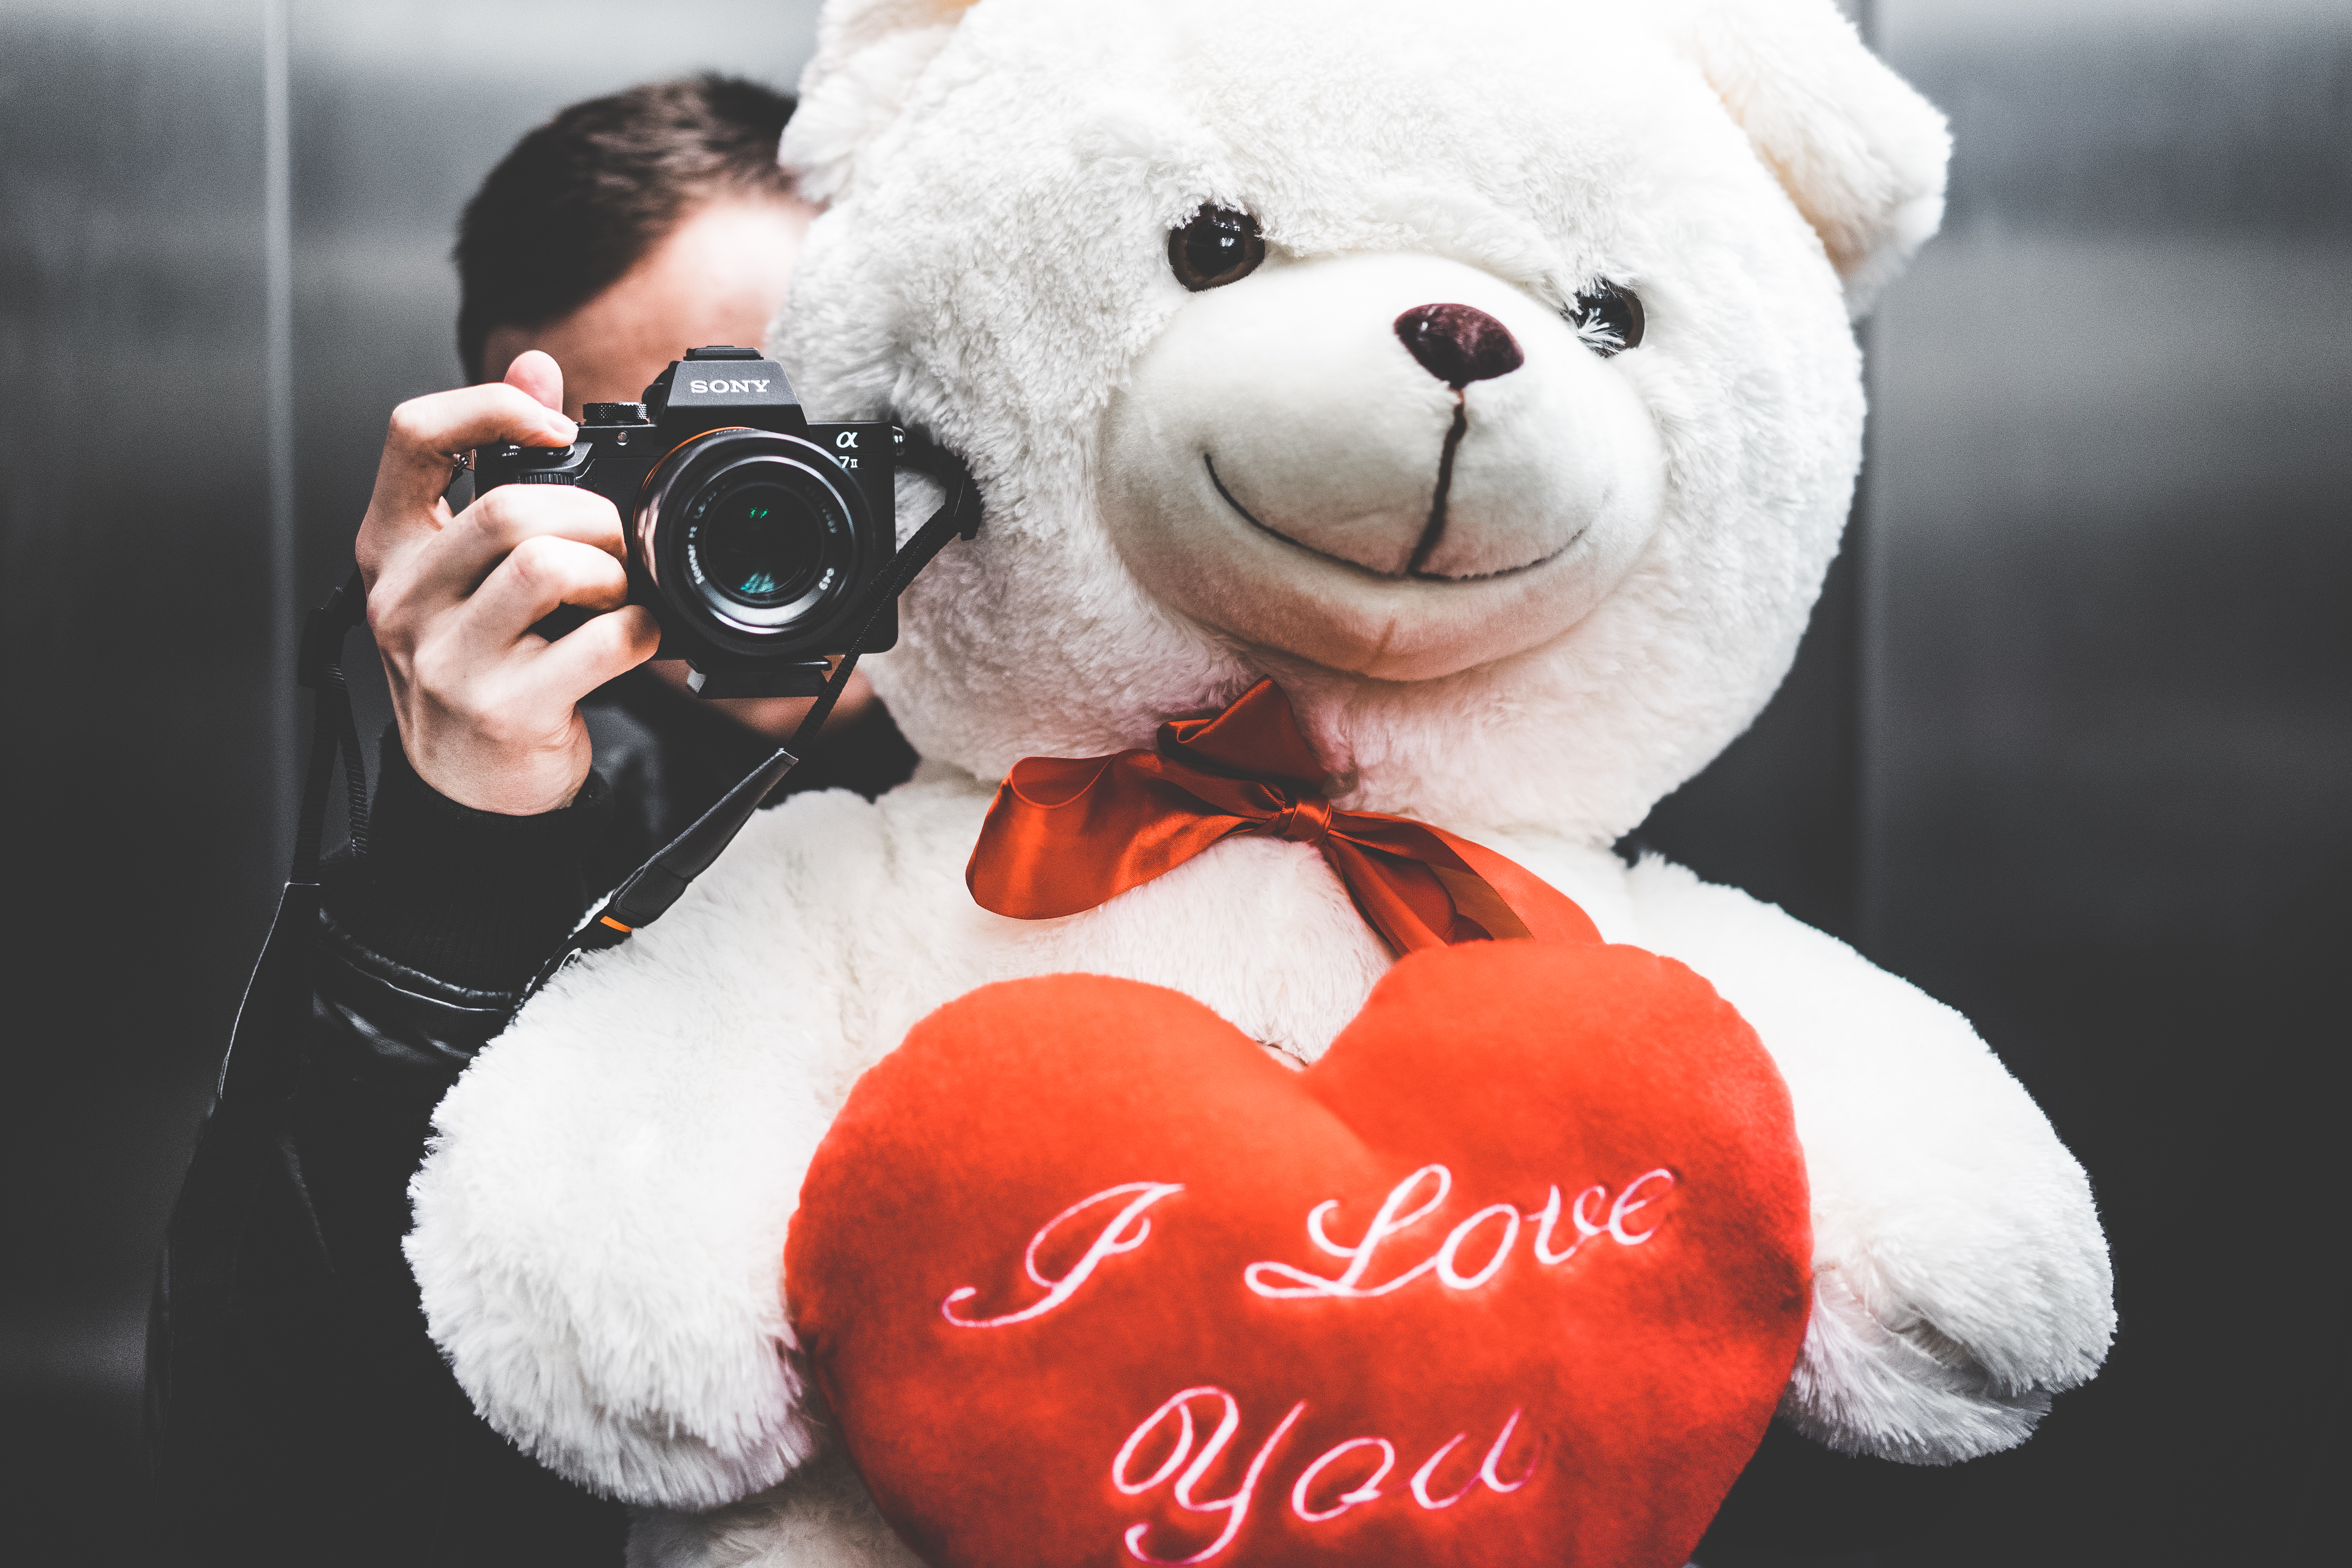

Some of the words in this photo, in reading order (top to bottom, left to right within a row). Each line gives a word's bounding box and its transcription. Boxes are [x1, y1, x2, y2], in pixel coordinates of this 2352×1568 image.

[690, 380, 771, 393] SONY
[1244, 1163, 1679, 1298] Love
[1112, 1385, 1545, 1566] You
